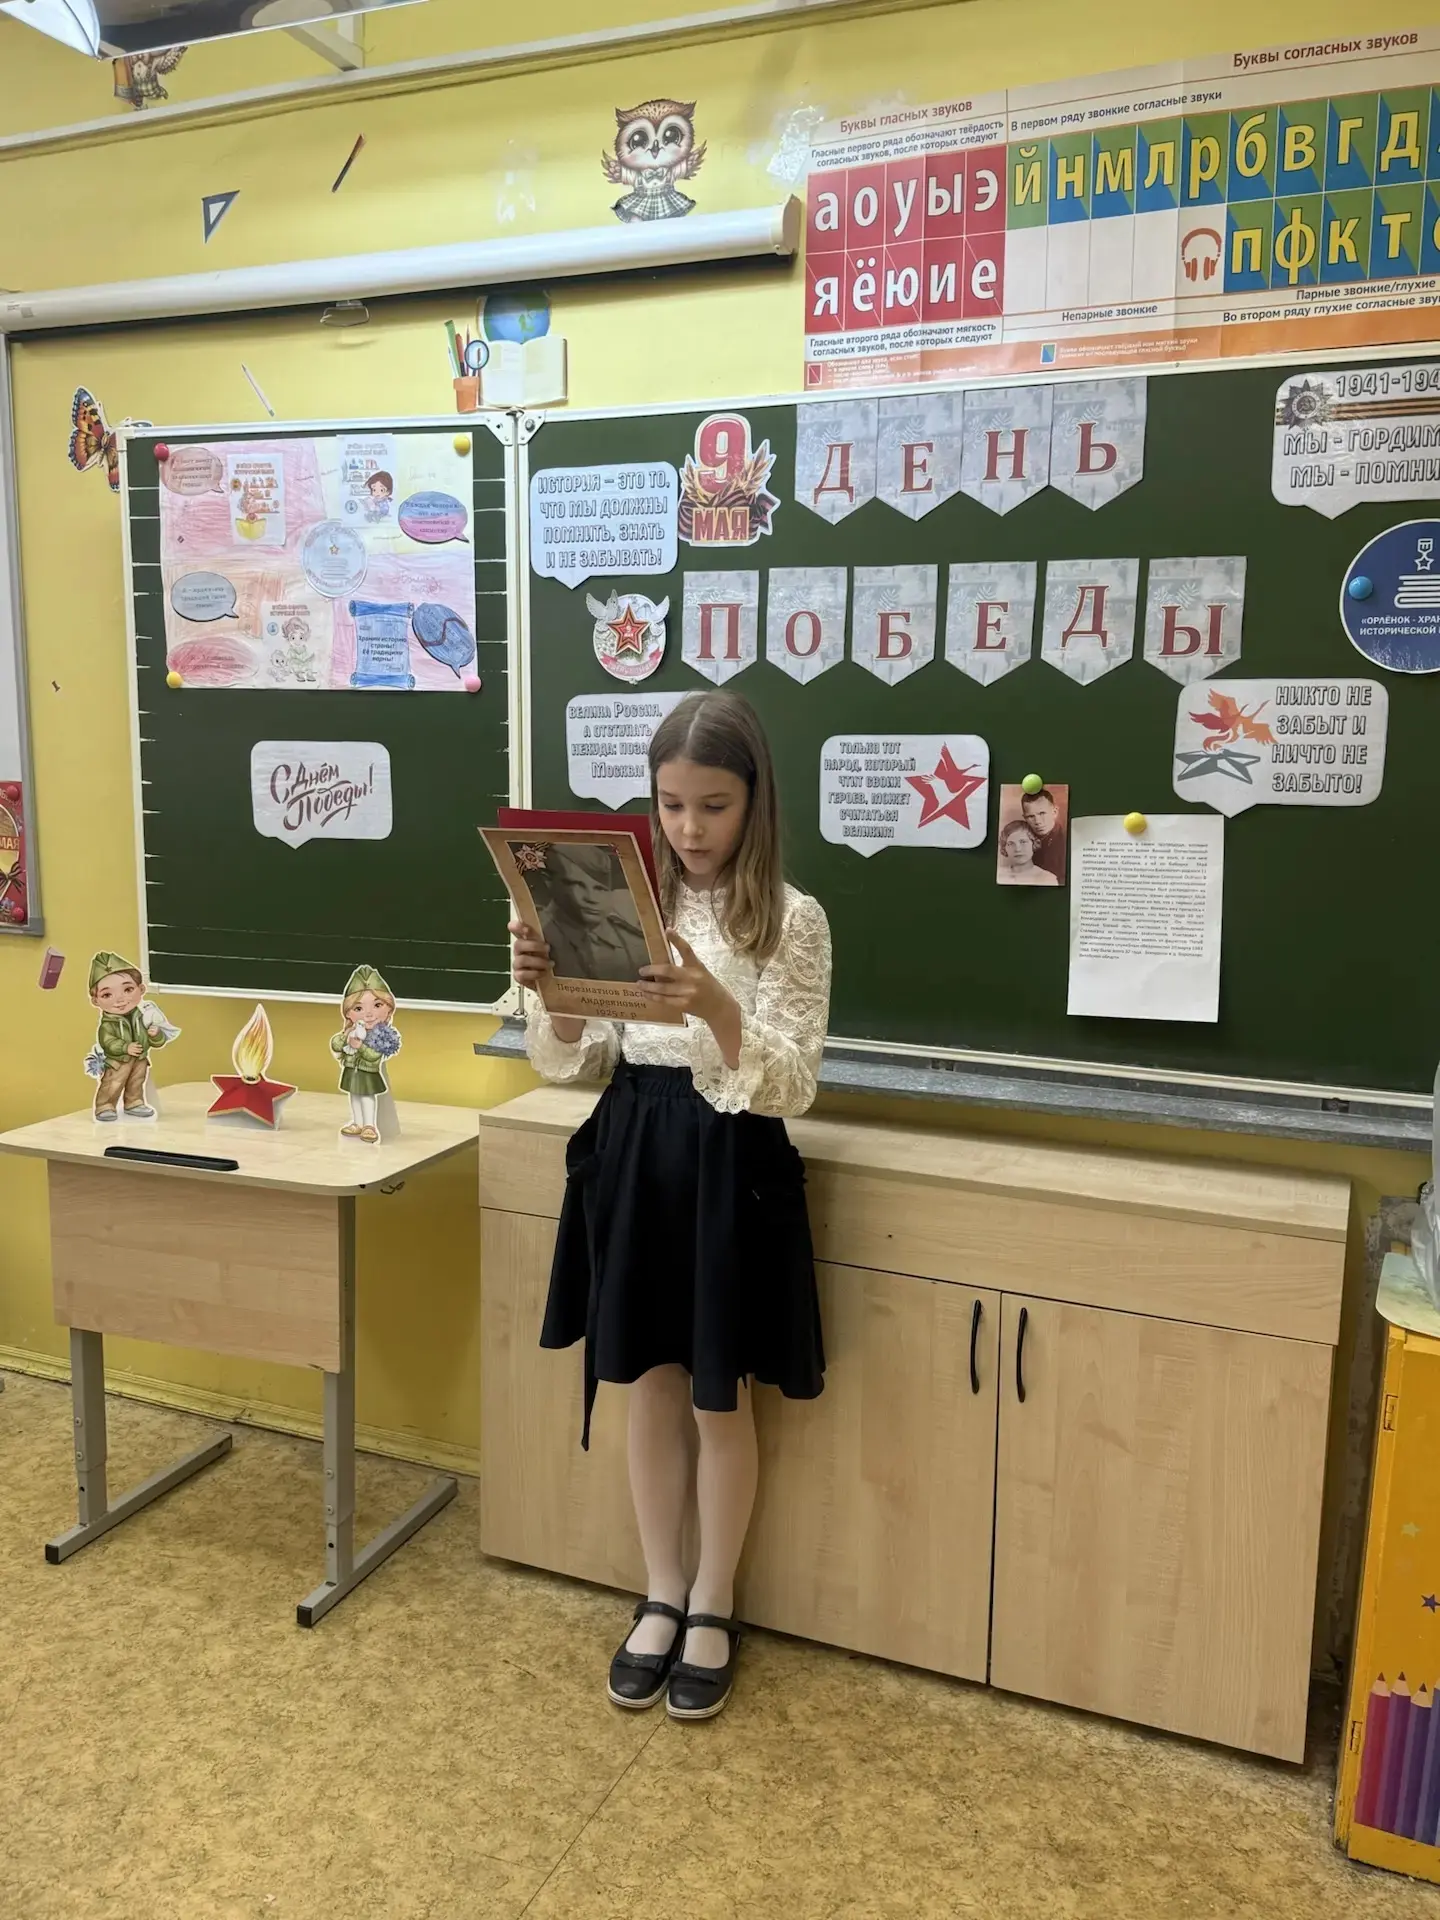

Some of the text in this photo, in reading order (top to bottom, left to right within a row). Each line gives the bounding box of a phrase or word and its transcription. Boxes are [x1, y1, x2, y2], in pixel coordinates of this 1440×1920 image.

[1233, 31, 1418, 69] Буквы согласных звуков
[840, 101, 972, 135] Буквы гласных звуков
[1011, 91, 1222, 133] В первом ряду звонкие согласные звуки
[811, 121, 1004, 159] Гласные первого ряда обозначают твёрдость
[817, 132, 997, 167] согласных звуков, после которых следуют
[1296, 278, 1436, 301] Парные звонкие/глухие
[1062, 304, 1158, 322] Непарные звонкие
[1223, 312, 1237, 322] Во
[1240, 308, 1280, 322] втором
[1284, 305, 1311, 320] ряду
[1314, 301, 1353, 316] глухие
[1356, 296, 1415, 311] согласные
[810, 323, 996, 348] Гласные второго ряда обозначают мягкость
[813, 333, 992, 357] согласных звуков, после которых следуют
[1283, 430, 1328, 456] МЫ
[1348, 425, 1440, 453] ГОРДИМ
[699, 417, 747, 495] 9
[537, 474, 600, 494] ИСТОРИЯ
[618, 472, 645, 489] ЭТО
[649, 471, 671, 489] ТО,
[1290, 463, 1334, 488] МЫ
[1355, 458, 1440, 485] ПОМНИ
[539, 496, 668, 519] ЧТО МЫ ДОЛЖНЫ
[543, 523, 665, 545] ПОМНИТЬ, ЗНАТЬ
[693, 507, 750, 543] МАЯ
[546, 548, 663, 568] И НЕ ЗАБЫВАТЬ!
[1360, 625, 1436, 636] ИСТОРИЧЕСКОЙ
[1361, 615, 1410, 625] «ОРЛЁНОК
[1275, 686, 1372, 706] НИКТО НЕ
[1276, 715, 1367, 736] ЗАБЫТ И
[839, 742, 901, 754] ТОЛЬКО ТОТ
[1271, 744, 1368, 765] НИЧТО НЕ
[824, 757, 916, 772] НАРОД, КОТОРЫЙ
[270, 764, 291, 804] С
[838, 775, 863, 788] ЧТИТ
[1272, 773, 1363, 794] ЗАБЫТО!
[283, 762, 375, 831] Победы!
[828, 792, 911, 806] ГЕРОЕВ, МОЖЕТ
[839, 809, 899, 822] СЧИТАТЬСЯ
[842, 824, 895, 839] ВЕЛИКИМ
